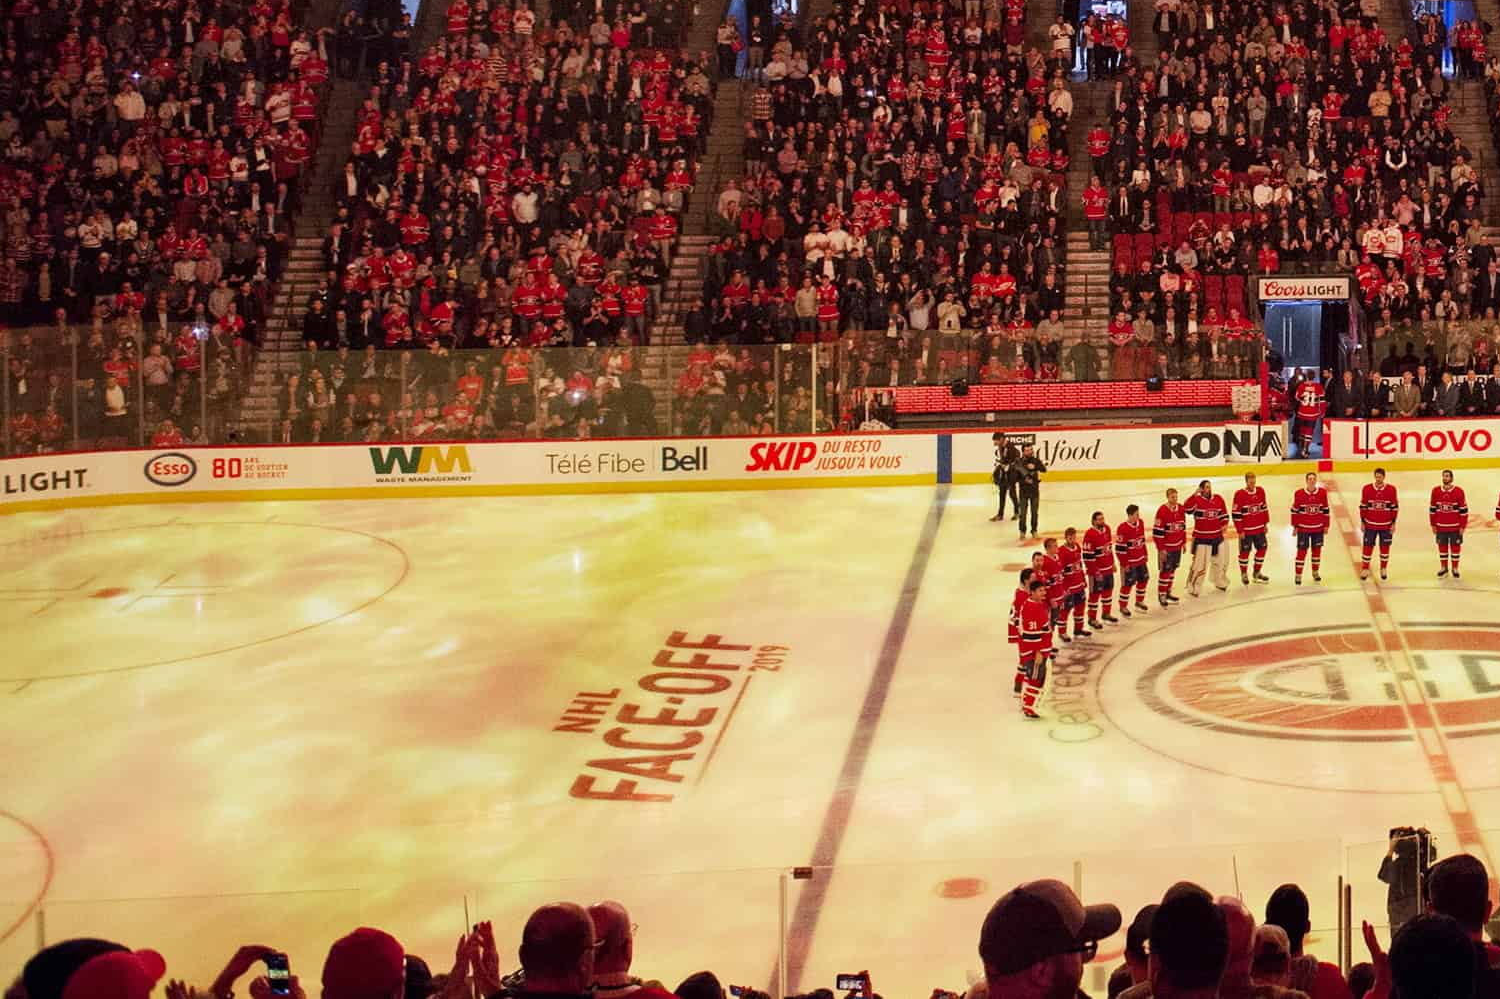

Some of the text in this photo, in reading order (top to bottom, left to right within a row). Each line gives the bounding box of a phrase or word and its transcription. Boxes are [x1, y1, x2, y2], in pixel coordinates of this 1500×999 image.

[1264, 281, 1343, 297] Coors LIGHT
[1160, 430, 1284, 461] RONA
[1352, 425, 1493, 456] Lenovo
[153, 461, 190, 477] Esso
[212, 457, 242, 479] 80
[368, 445, 473, 475] WM
[545, 446, 708, 475] Télé Fibe Bell
[745, 439, 882, 472] SKIP DU RESTO
[868, 453, 903, 469] VOUS
[4, 468, 88, 494] LIGHT
[752, 644, 791, 673] 2019
[551, 687, 621, 734] NHL
[567, 630, 753, 803] FACE-OFF
